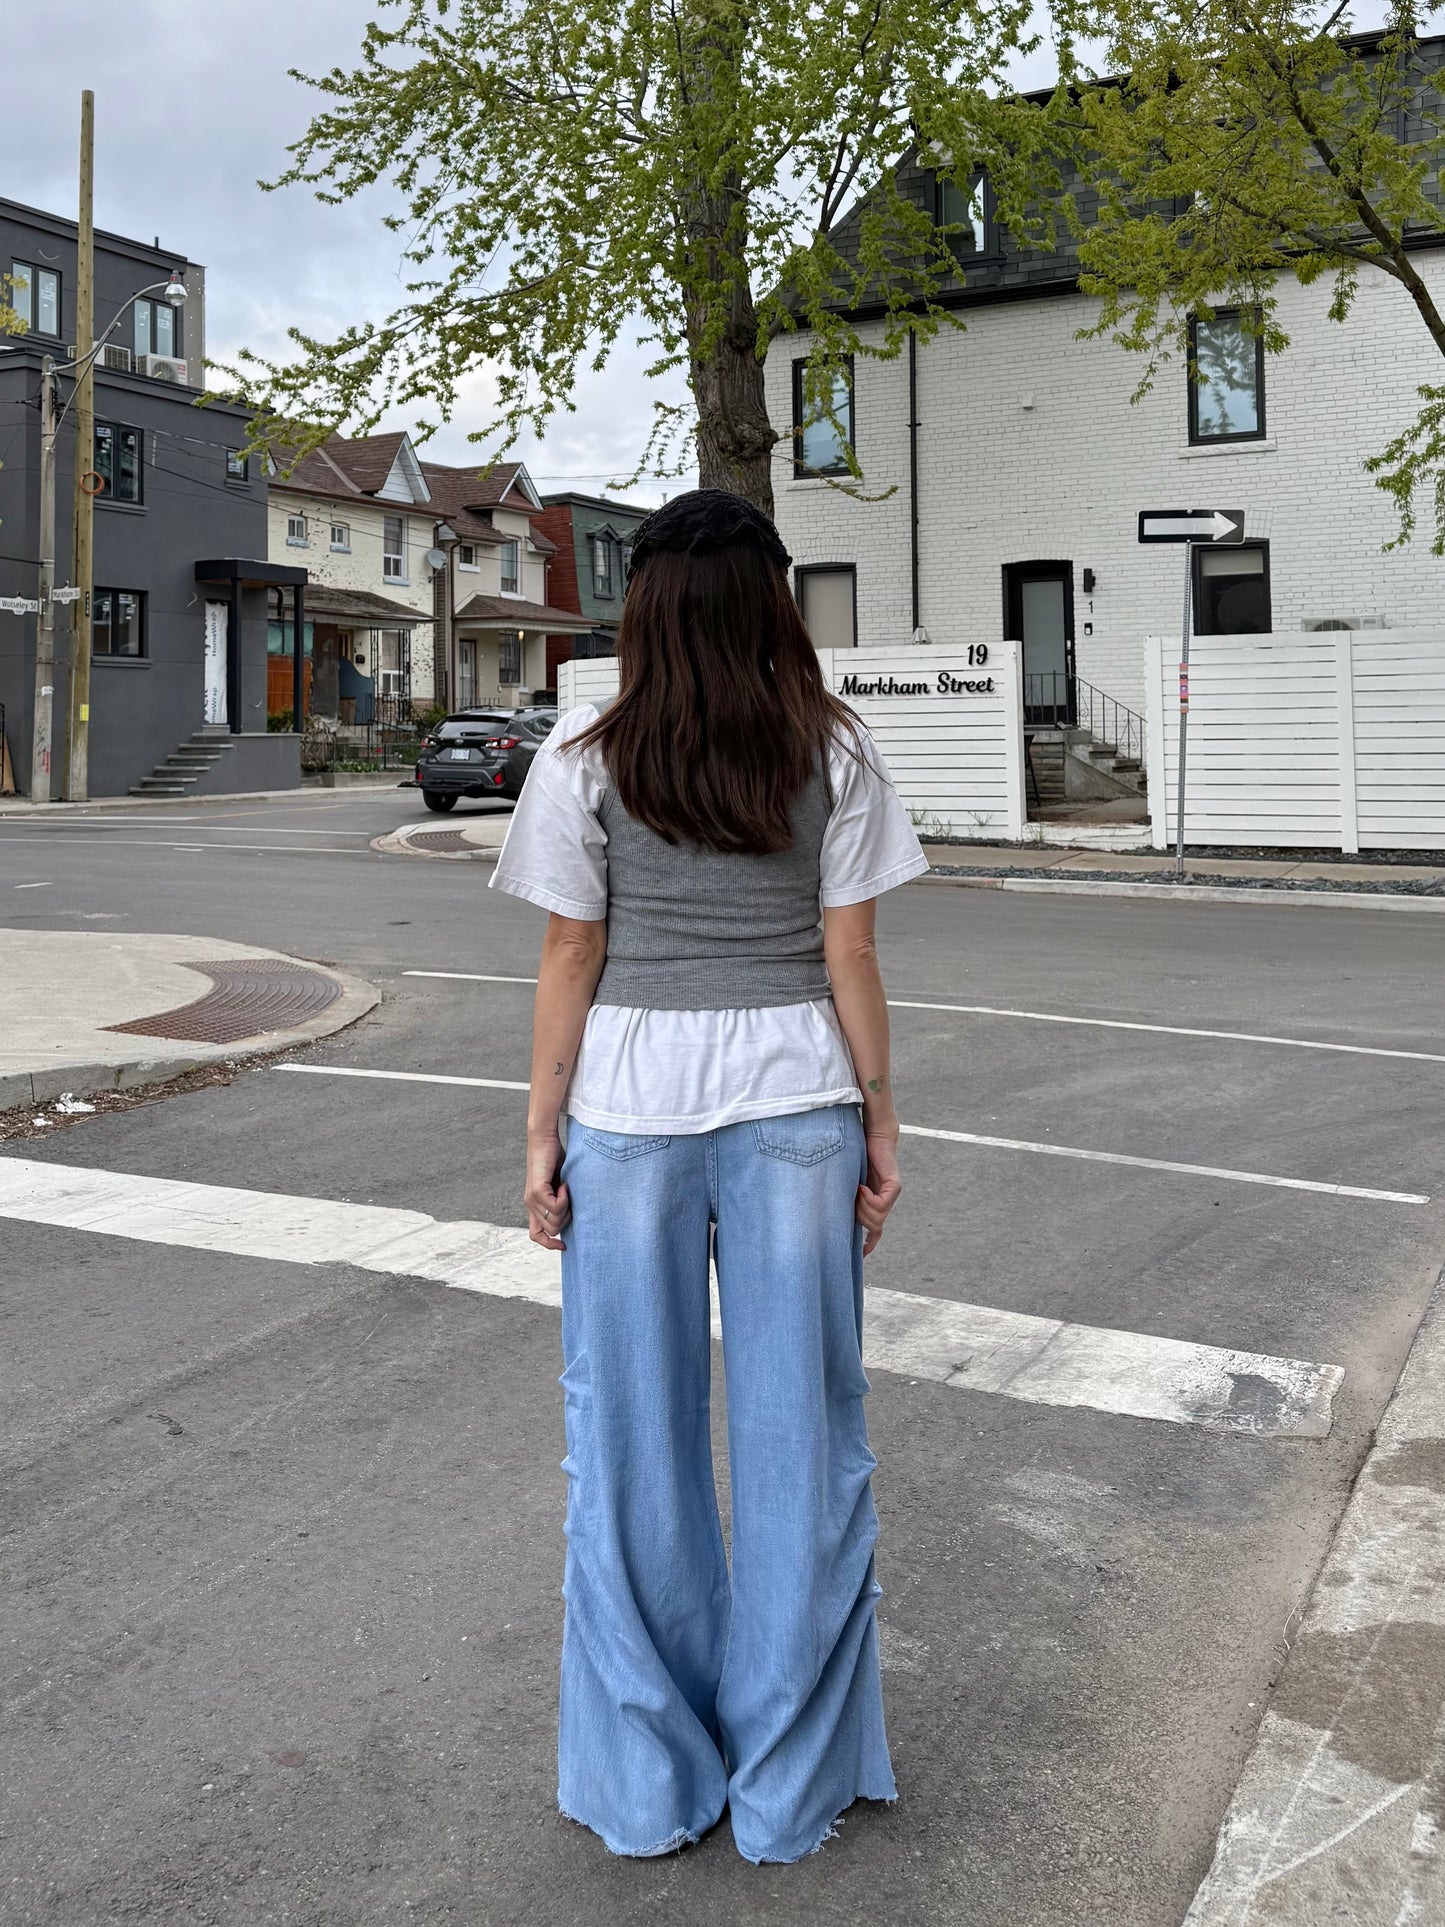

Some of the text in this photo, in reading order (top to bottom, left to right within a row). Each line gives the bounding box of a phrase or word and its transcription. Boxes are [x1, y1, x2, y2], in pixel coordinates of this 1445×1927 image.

[53, 589, 80, 598] Markham St
[1, 600, 37, 611] Wolseley St
[1088, 600, 1094, 614] 1
[967, 643, 988, 666] 19
[838, 672, 995, 696] Markham Street
